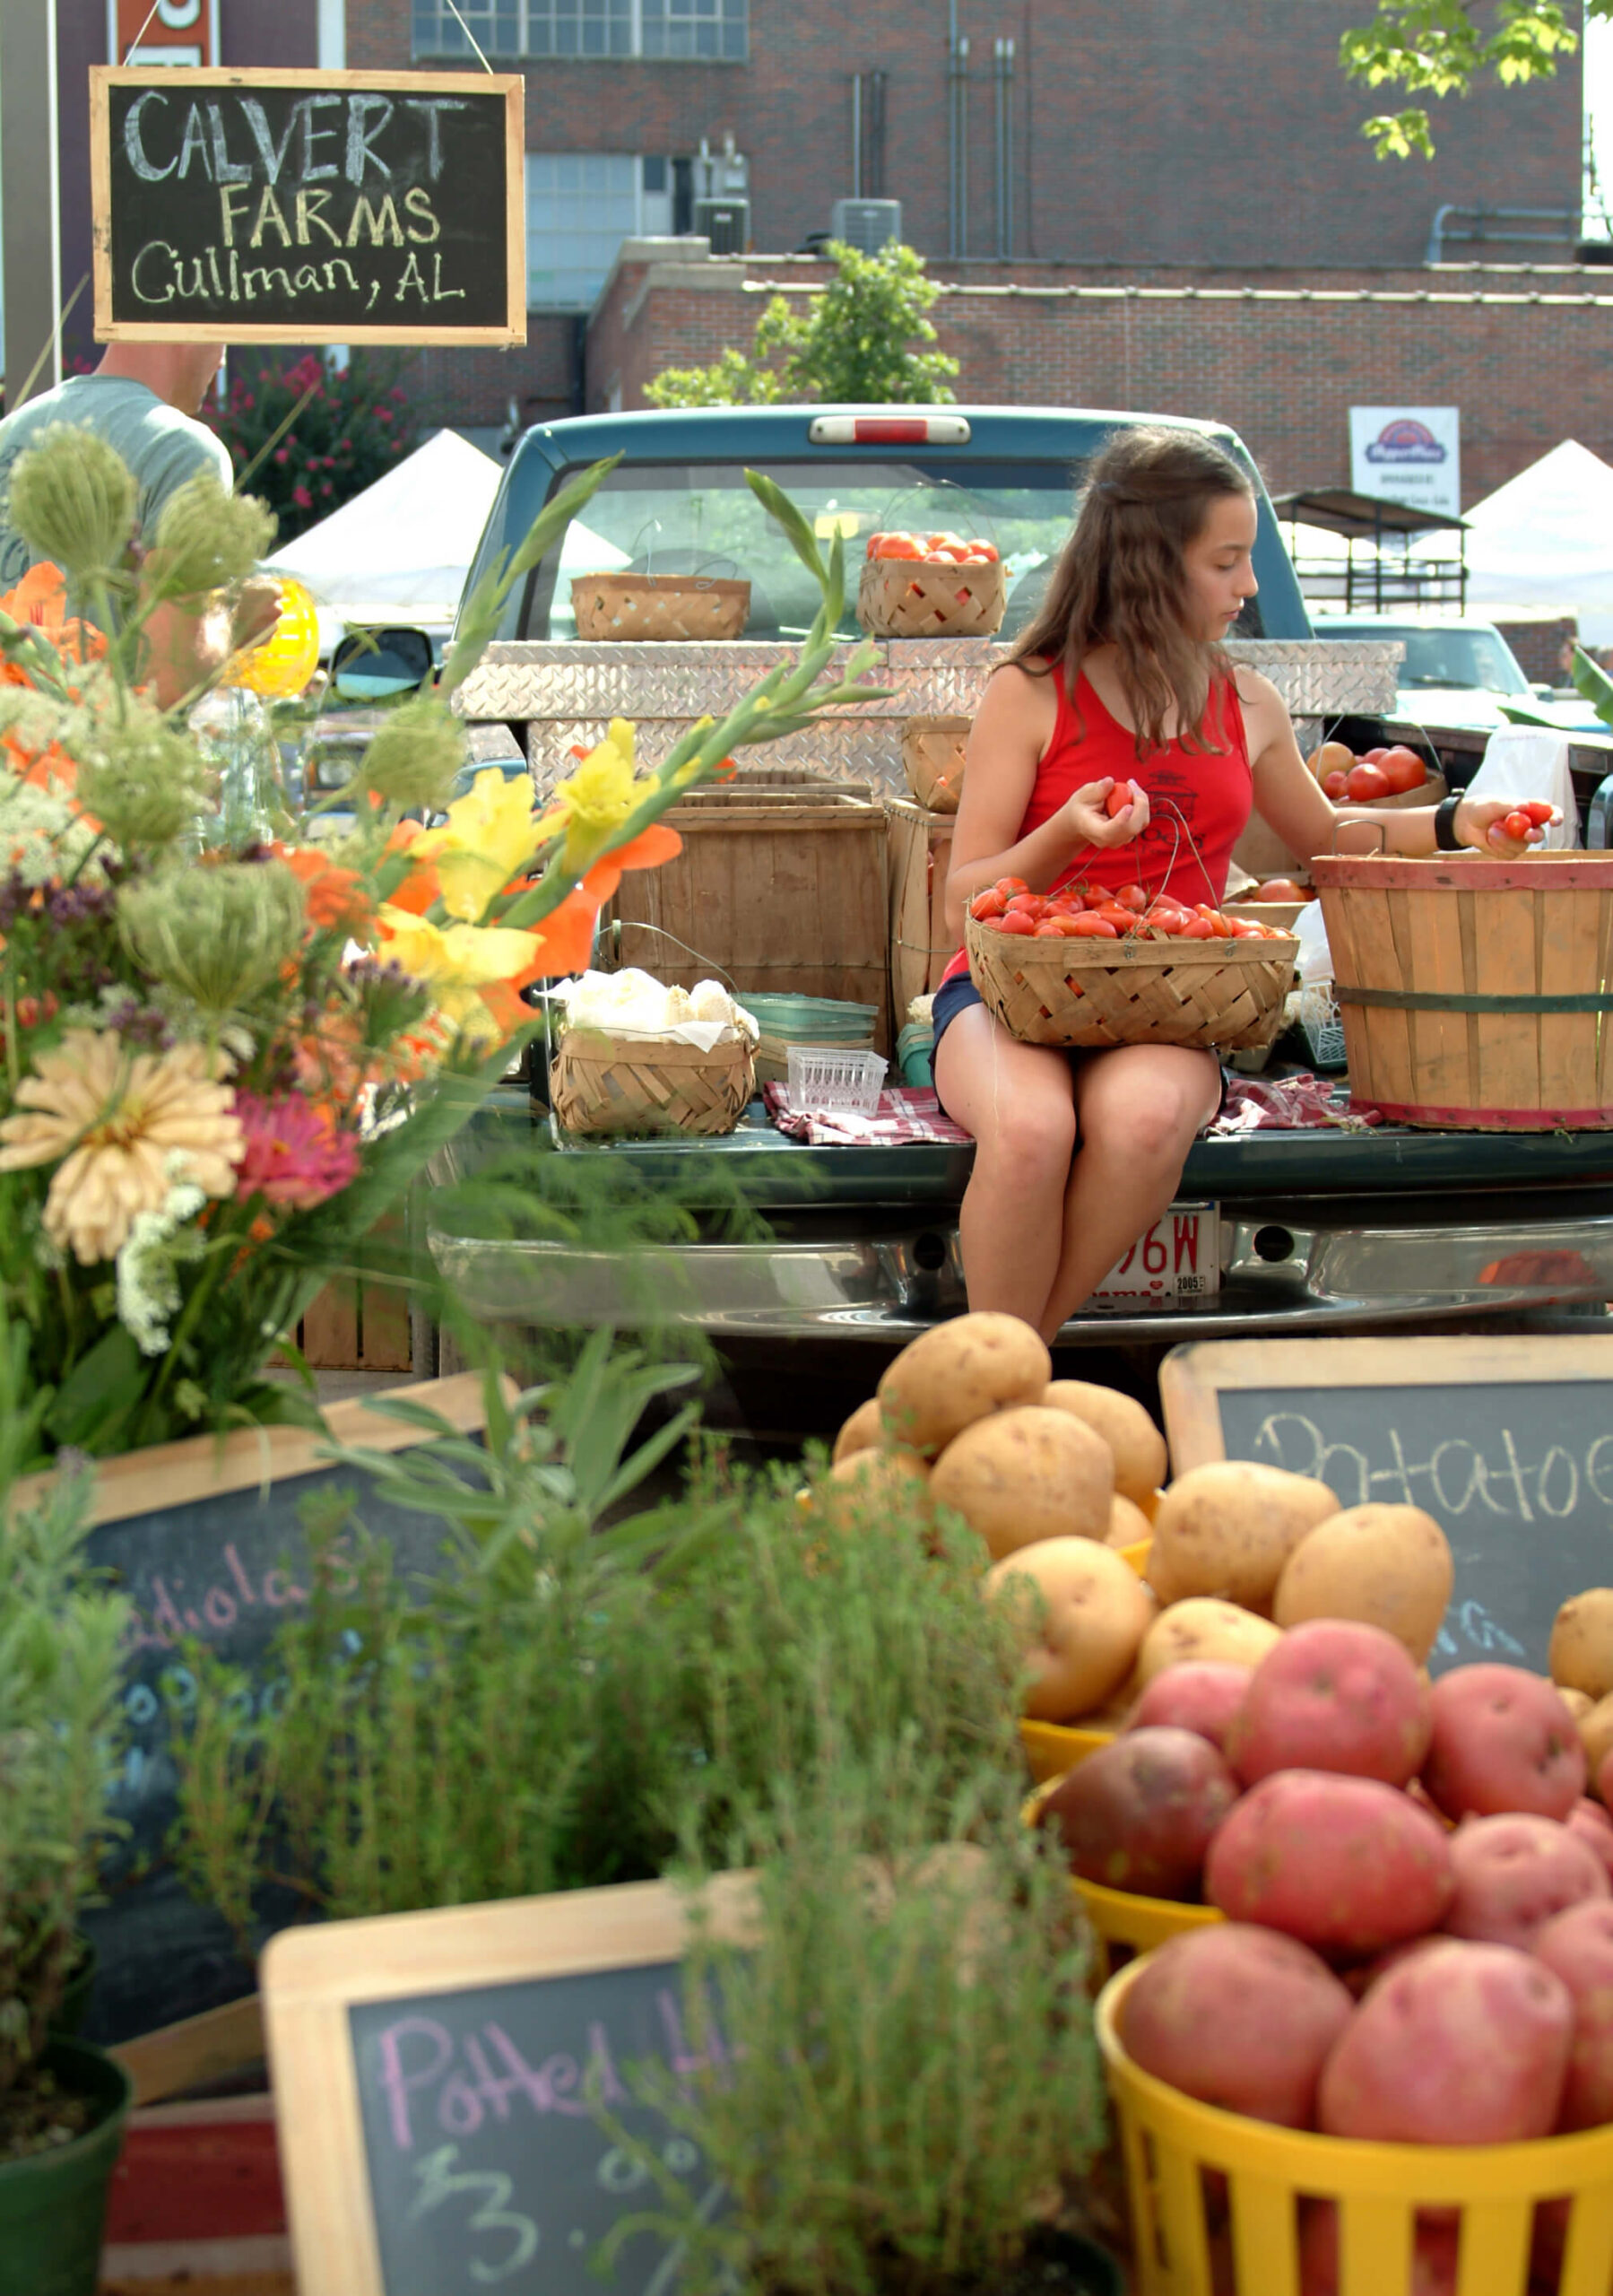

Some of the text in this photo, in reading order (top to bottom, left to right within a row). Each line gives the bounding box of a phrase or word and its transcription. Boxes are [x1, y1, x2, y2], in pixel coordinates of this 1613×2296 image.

[124, 91, 472, 186] CALVERT
[219, 182, 442, 249] FARMS
[131, 240, 466, 309] Cullman, AL
[1177, 1276, 1198, 1290] 2005
[379, 2015, 626, 2149] Potted
